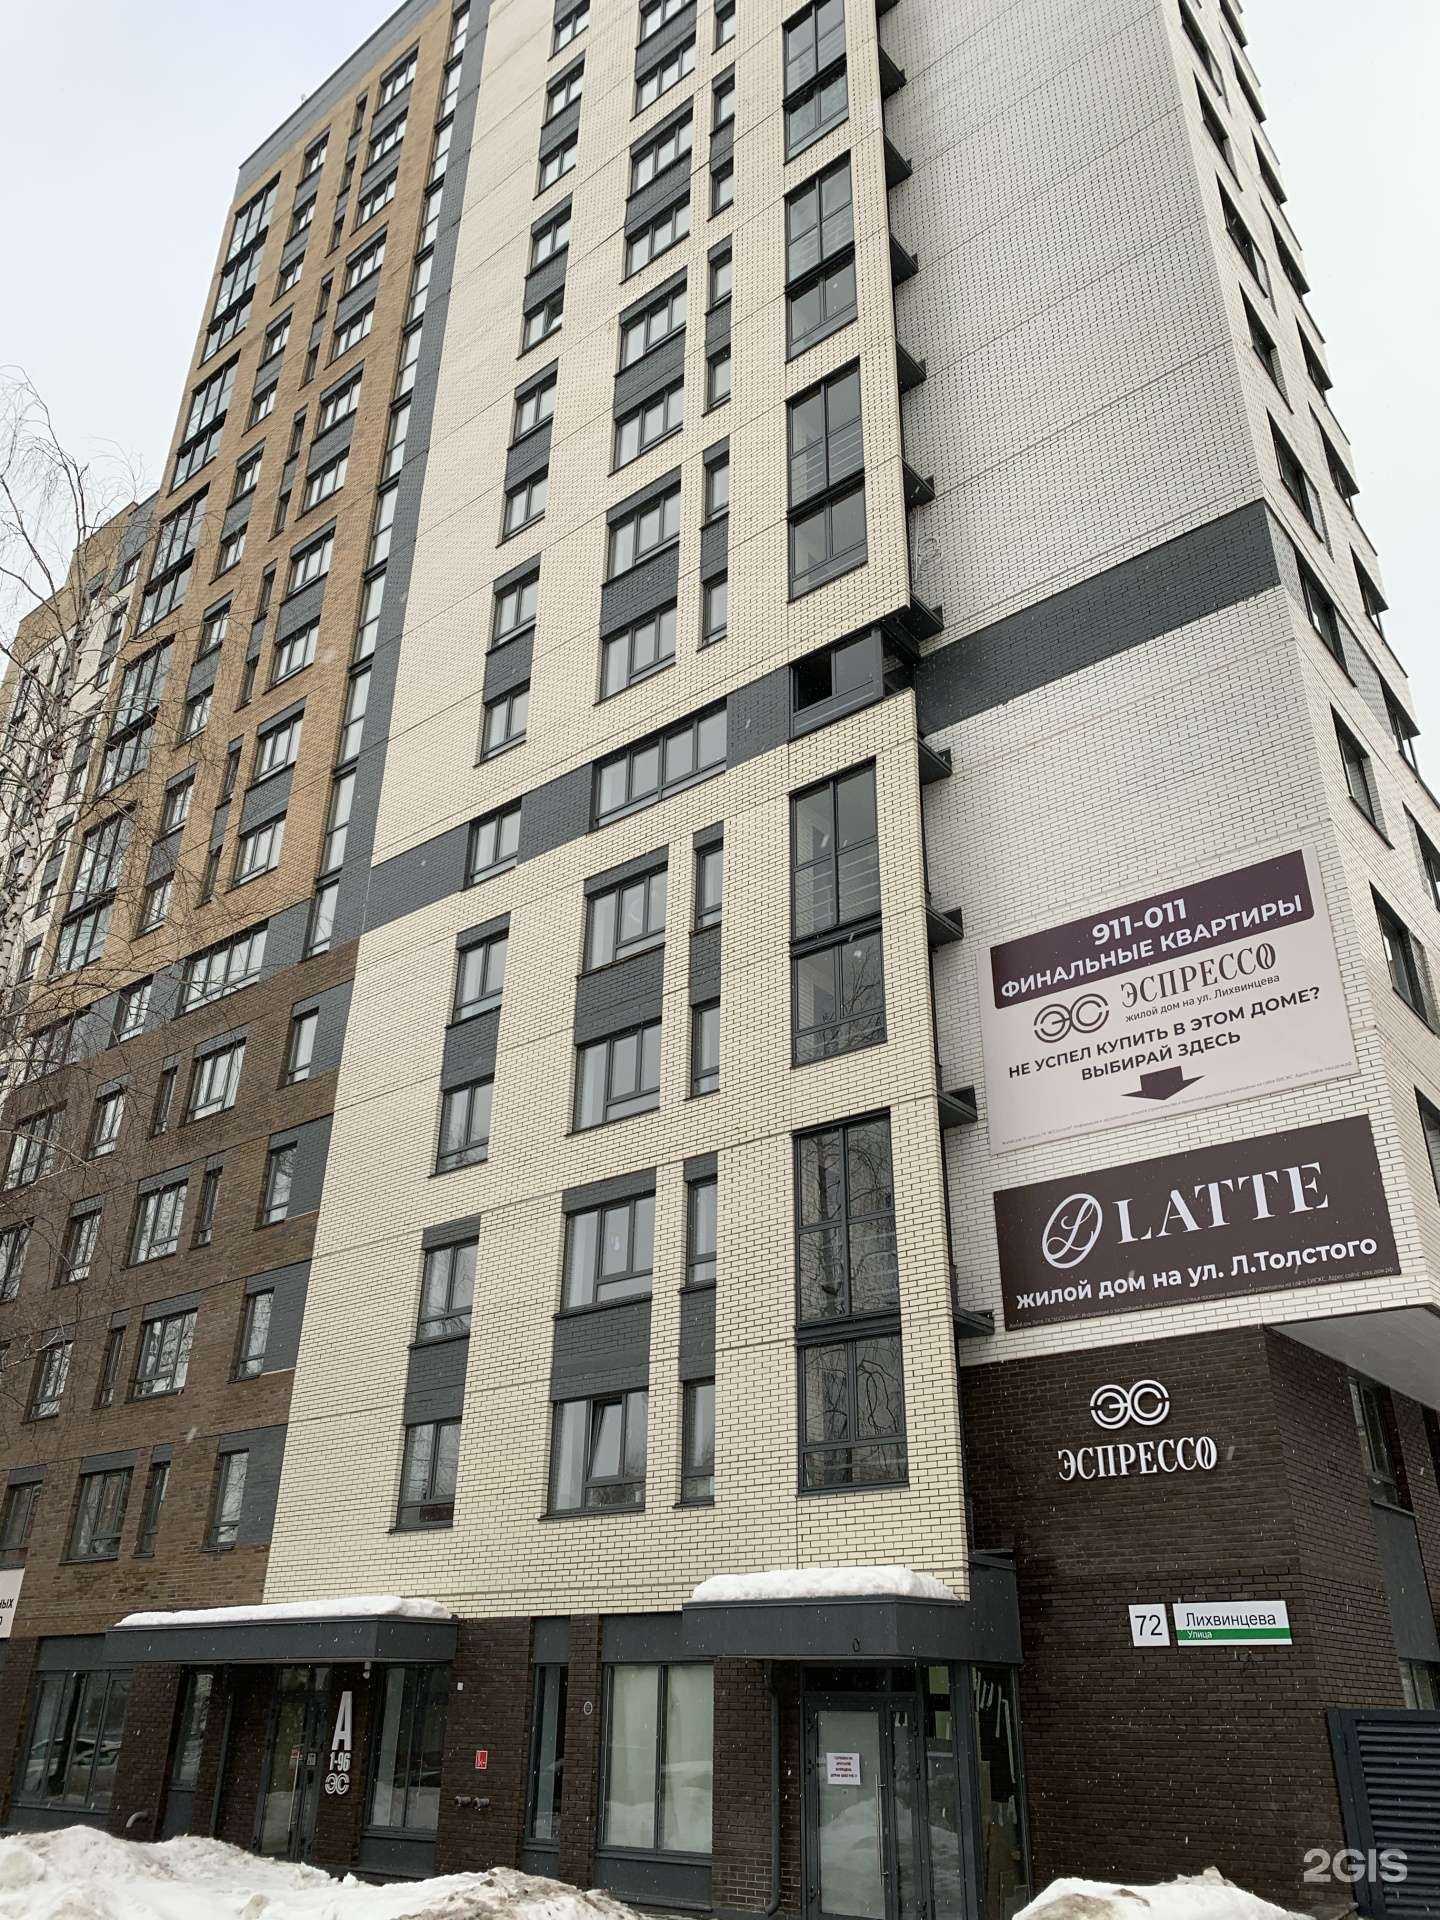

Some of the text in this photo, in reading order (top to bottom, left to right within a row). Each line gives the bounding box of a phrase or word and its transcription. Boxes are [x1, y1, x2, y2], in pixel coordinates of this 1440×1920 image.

[1001, 894, 1303, 997] ФИНАЛЬНЫЕ КВАРТИРЫ
[1092, 898, 1187, 946] 911-011
[1120, 942, 1276, 1008] ЭСПРЕССО
[1125, 975, 1280, 1022] жилой дом на ул. Лихвинцева
[1009, 986, 1320, 1078] НЕ УСПЕЛ КУПИТЬ В ЭТОМ ДОМЕ?
[1081, 1031, 1241, 1080] ВЫБИРАЙ ЗДЕСЬ
[1112, 1161, 1329, 1244] LATTE
[1016, 1279, 1092, 1310] жилой
[1098, 1274, 1146, 1299] дом
[1152, 1269, 1182, 1288] на
[1188, 1263, 1225, 1288] ул.
[1231, 1238, 1378, 1276] Л.Толстого
[1057, 1436, 1218, 1481] ЭСПРЕССО
[1134, 1614, 1163, 1636] 72
[1185, 1612, 1277, 1628] Лихвинцева
[1187, 1630, 1213, 1639] Улица
[331, 1690, 353, 1751] А
[329, 1751, 352, 1772] 1-96
